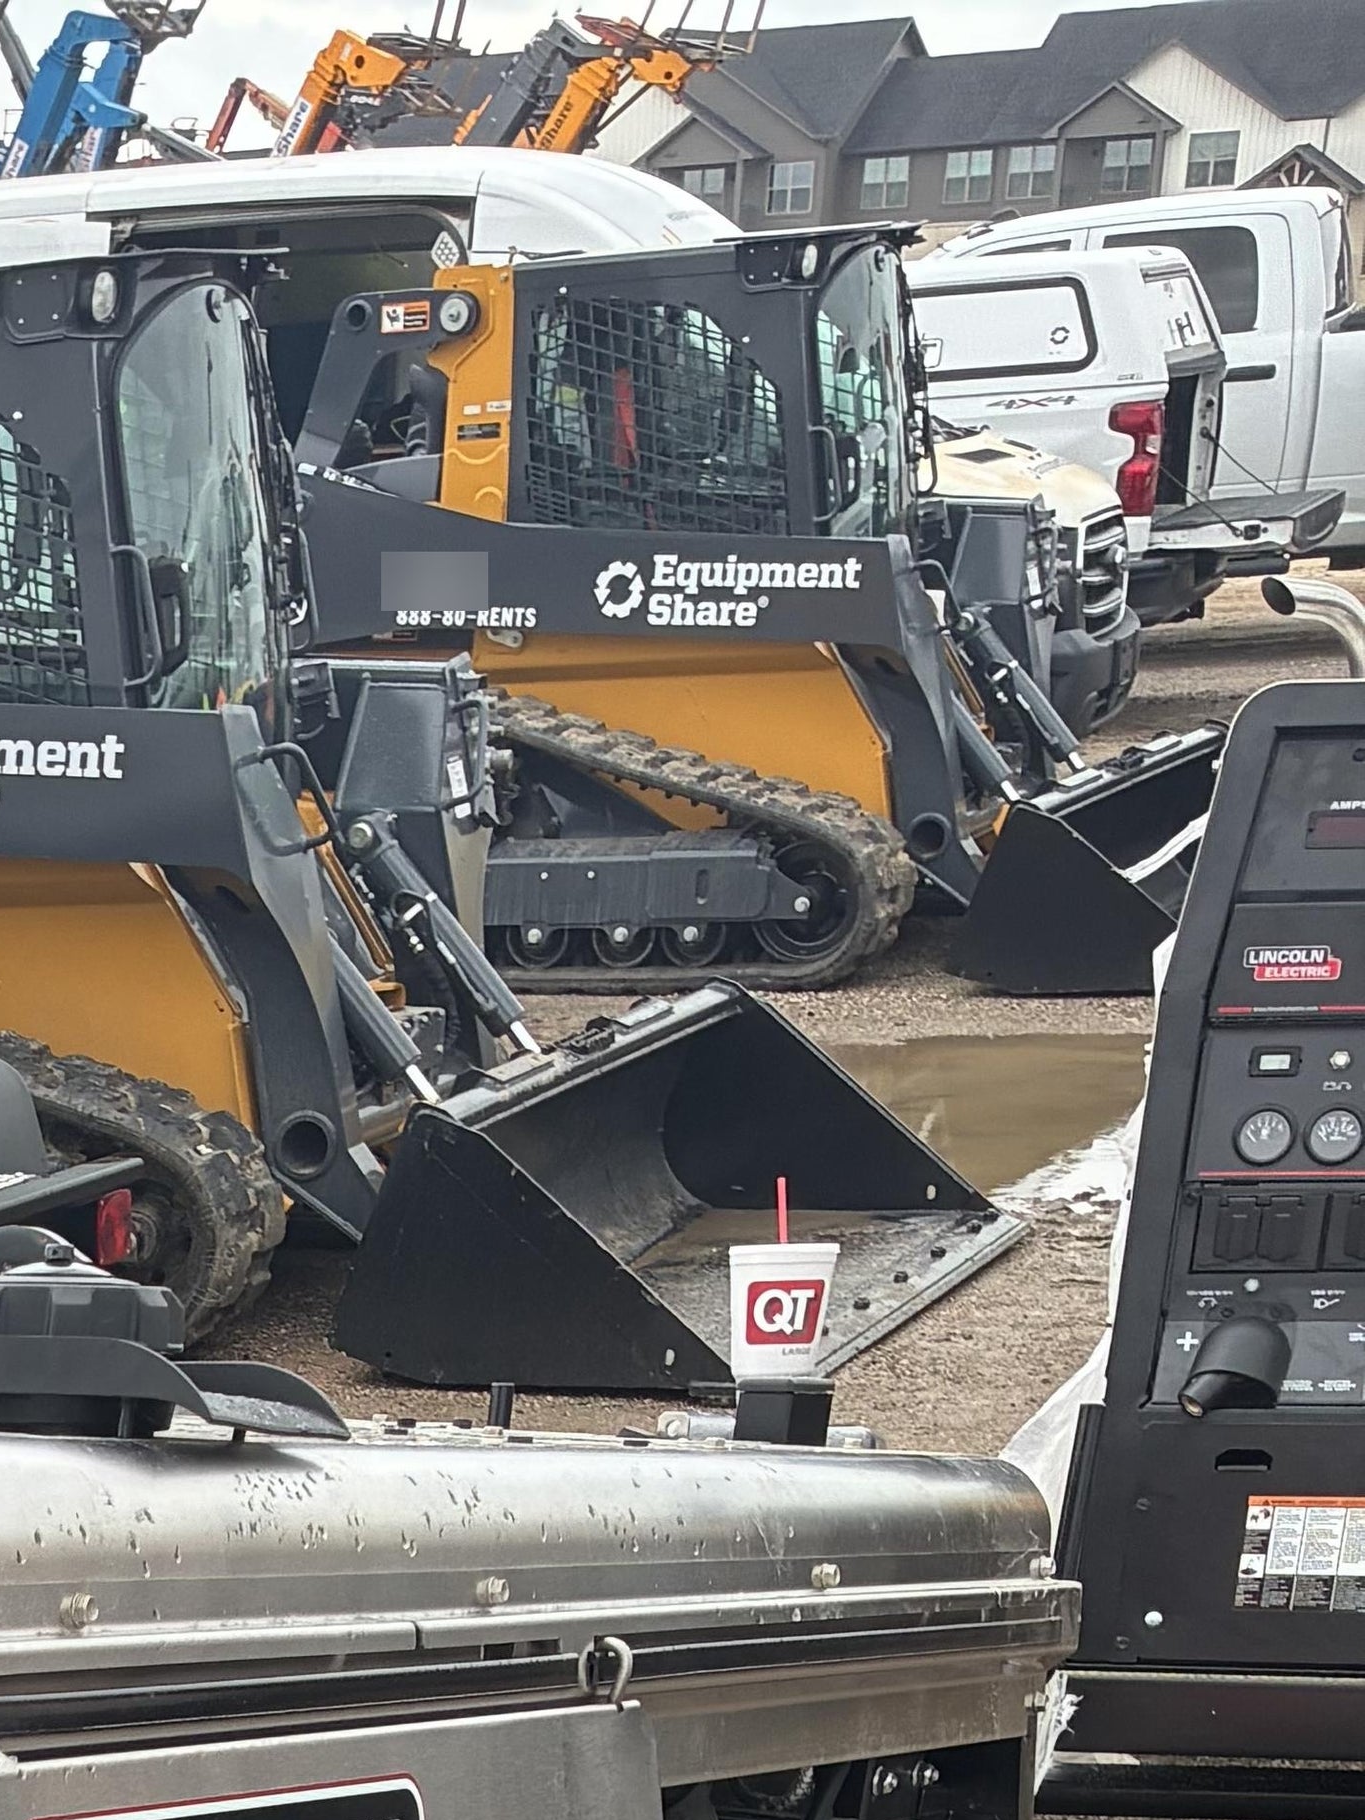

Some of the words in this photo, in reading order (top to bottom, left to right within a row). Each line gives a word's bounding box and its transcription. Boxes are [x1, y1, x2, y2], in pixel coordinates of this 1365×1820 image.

[650, 554, 862, 595] Equipment
[1249, 949, 1324, 967] LINCOLN
[1263, 963, 1332, 979] ELECTRIC
[753, 1288, 816, 1335] QT
